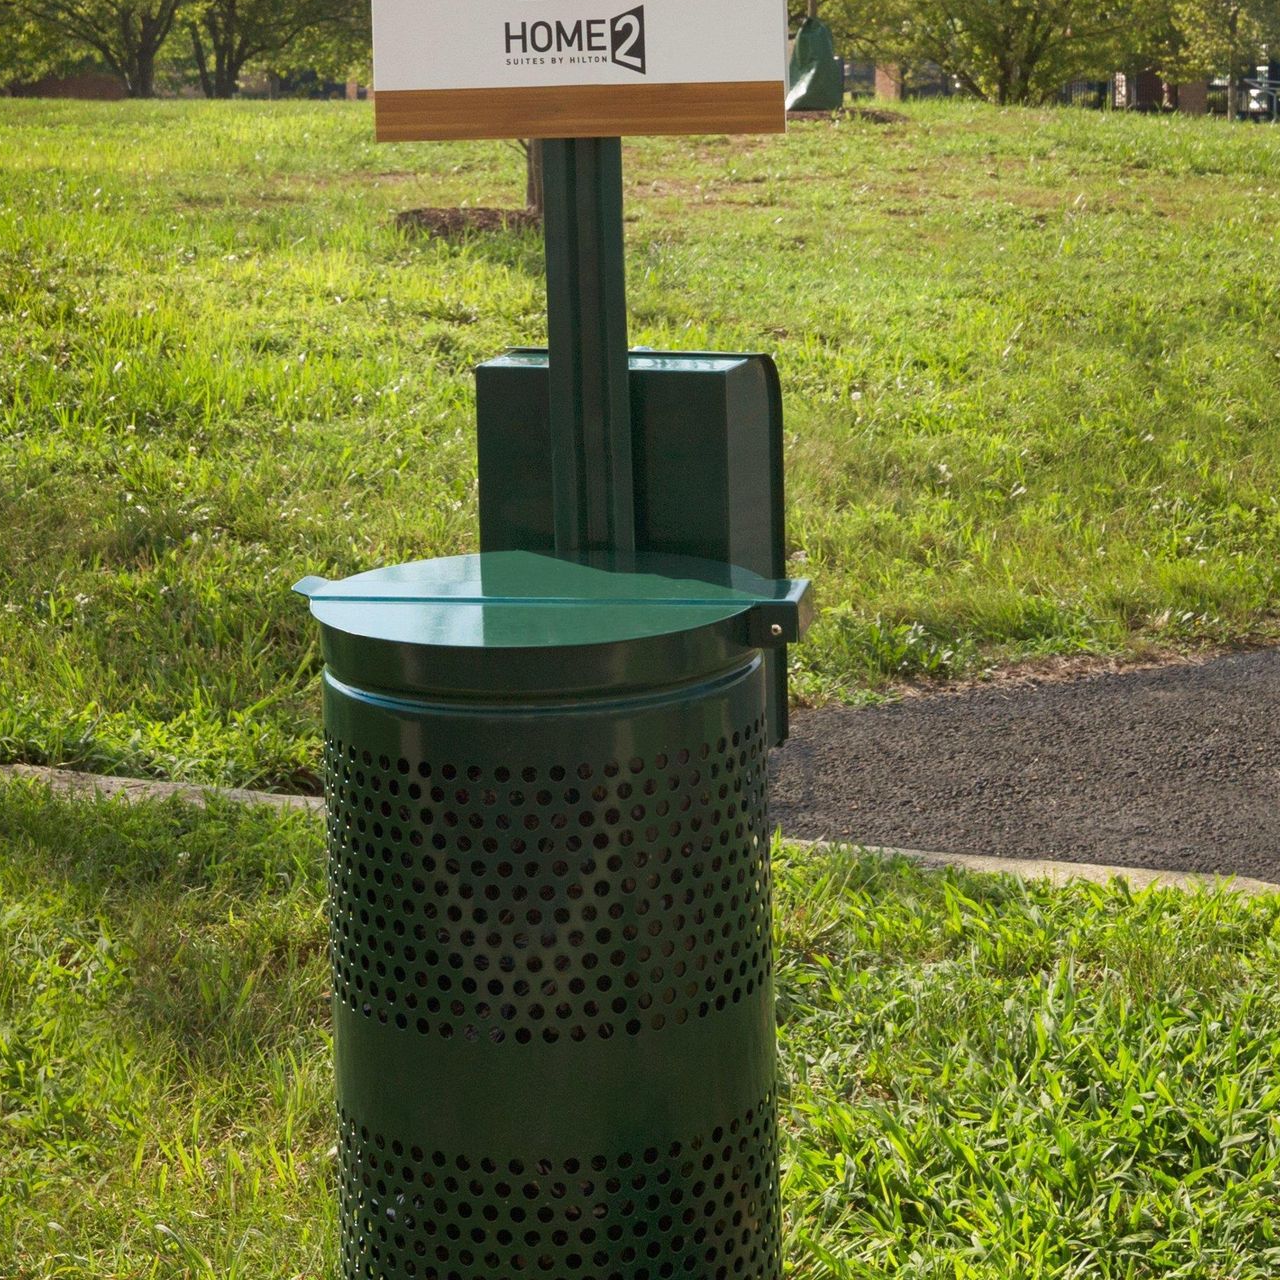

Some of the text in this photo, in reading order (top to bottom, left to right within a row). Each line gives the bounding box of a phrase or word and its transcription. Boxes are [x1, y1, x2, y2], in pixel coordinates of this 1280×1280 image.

[505, 55, 608, 66] SUITES BY HILTON
